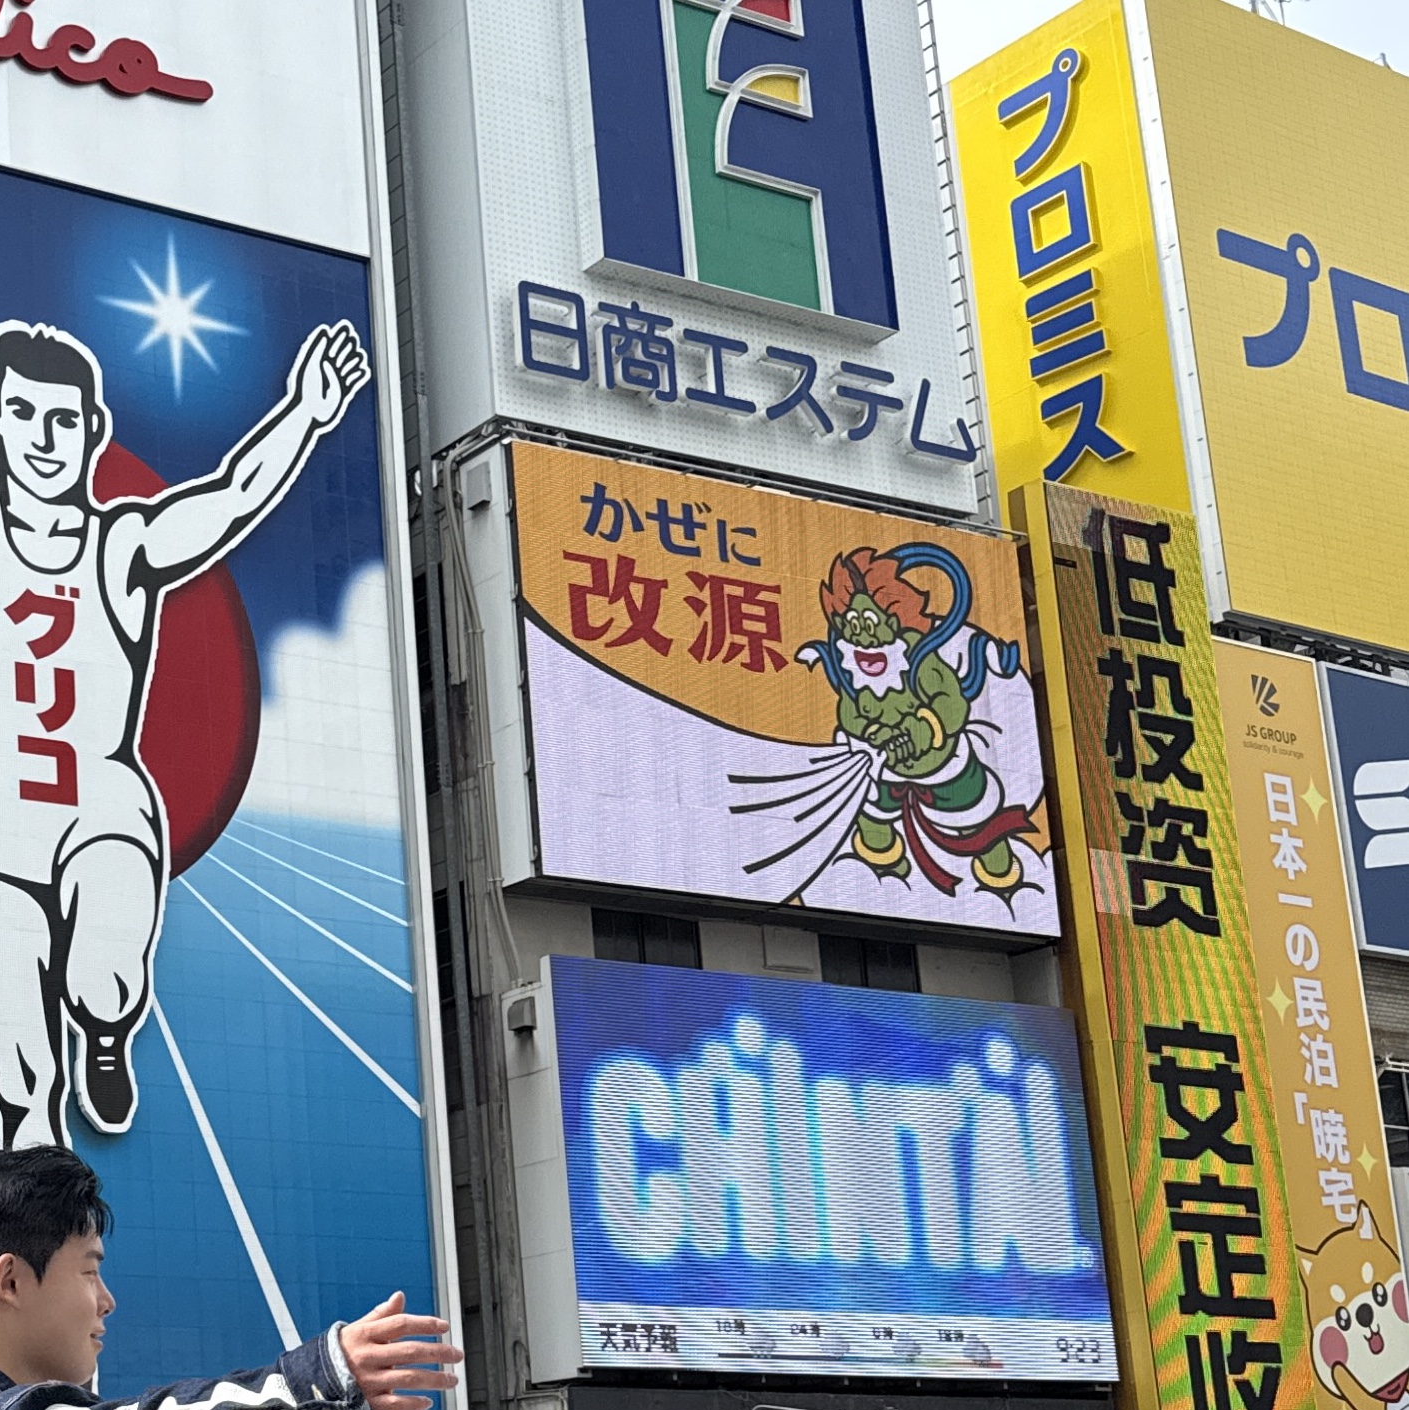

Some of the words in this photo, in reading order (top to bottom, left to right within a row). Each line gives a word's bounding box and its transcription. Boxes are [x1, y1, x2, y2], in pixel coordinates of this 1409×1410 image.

[996, 47, 1128, 483] プロミス
[1216, 228, 1409, 412] プロ
[516, 280, 977, 463] 日商エステム
[562, 549, 789, 674] 改源
[580, 482, 762, 567] かぜに
[3, 584, 81, 808] グリコ
[1245, 724, 1258, 739] JS
[1259, 726, 1297, 746] GROUP
